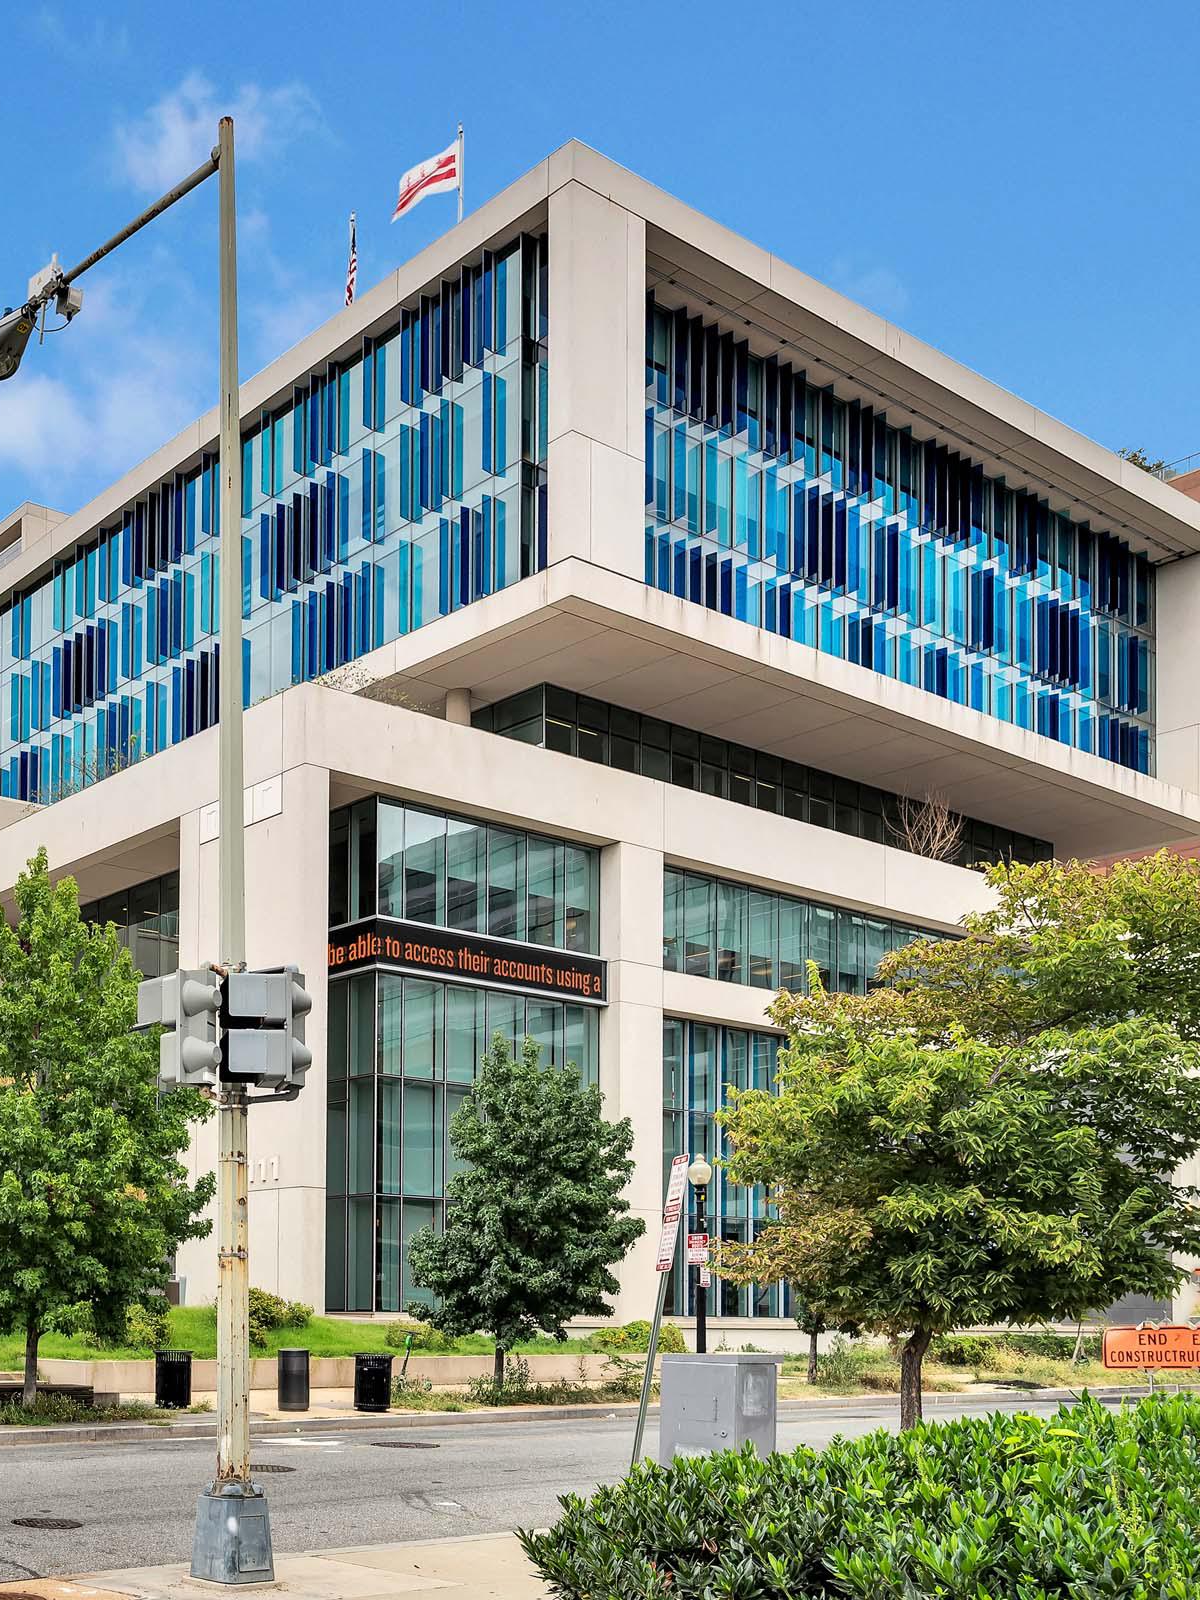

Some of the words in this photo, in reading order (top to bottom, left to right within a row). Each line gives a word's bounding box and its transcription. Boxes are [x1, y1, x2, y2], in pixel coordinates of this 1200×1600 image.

[328, 943, 344, 966] be
[349, 932, 381, 961] able
[385, 936, 400, 957] to
[405, 943, 454, 967] access
[458, 947, 490, 973] their
[494, 959, 553, 984] accounts
[557, 967, 591, 995] using
[594, 976, 601, 992] a
[1138, 1333, 1168, 1346] END
